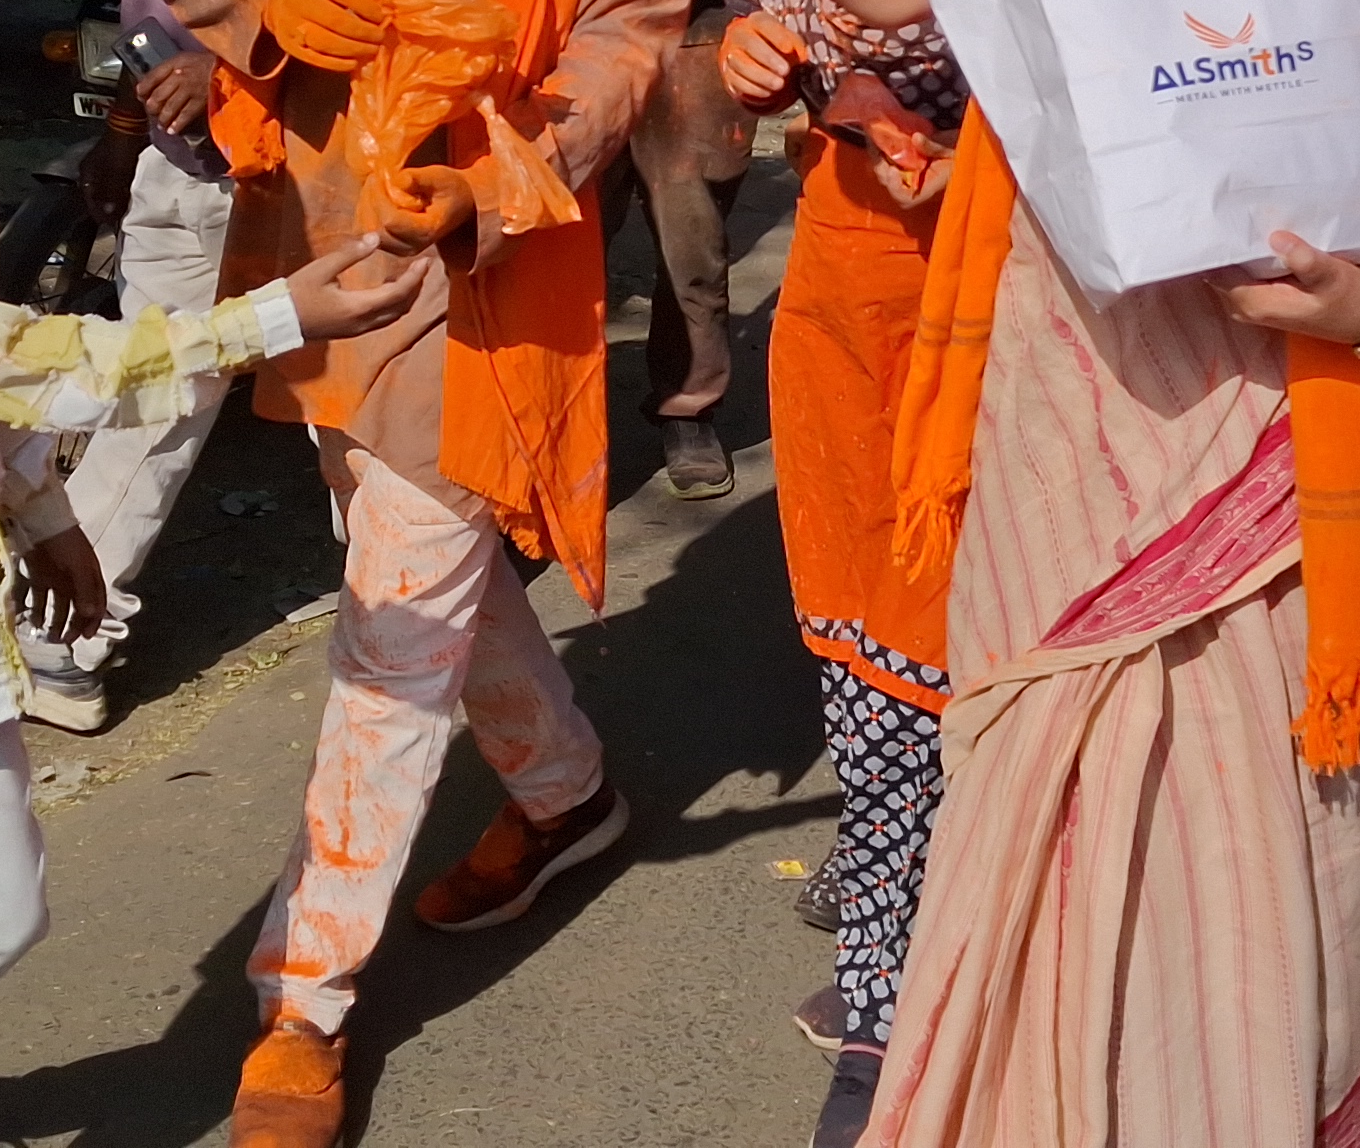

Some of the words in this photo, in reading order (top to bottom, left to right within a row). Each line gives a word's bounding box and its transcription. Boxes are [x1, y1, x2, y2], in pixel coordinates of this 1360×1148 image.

[1175, 90, 1217, 104] METAL
[1220, 86, 1252, 98] WITH
[1255, 79, 1304, 93] METTLE
